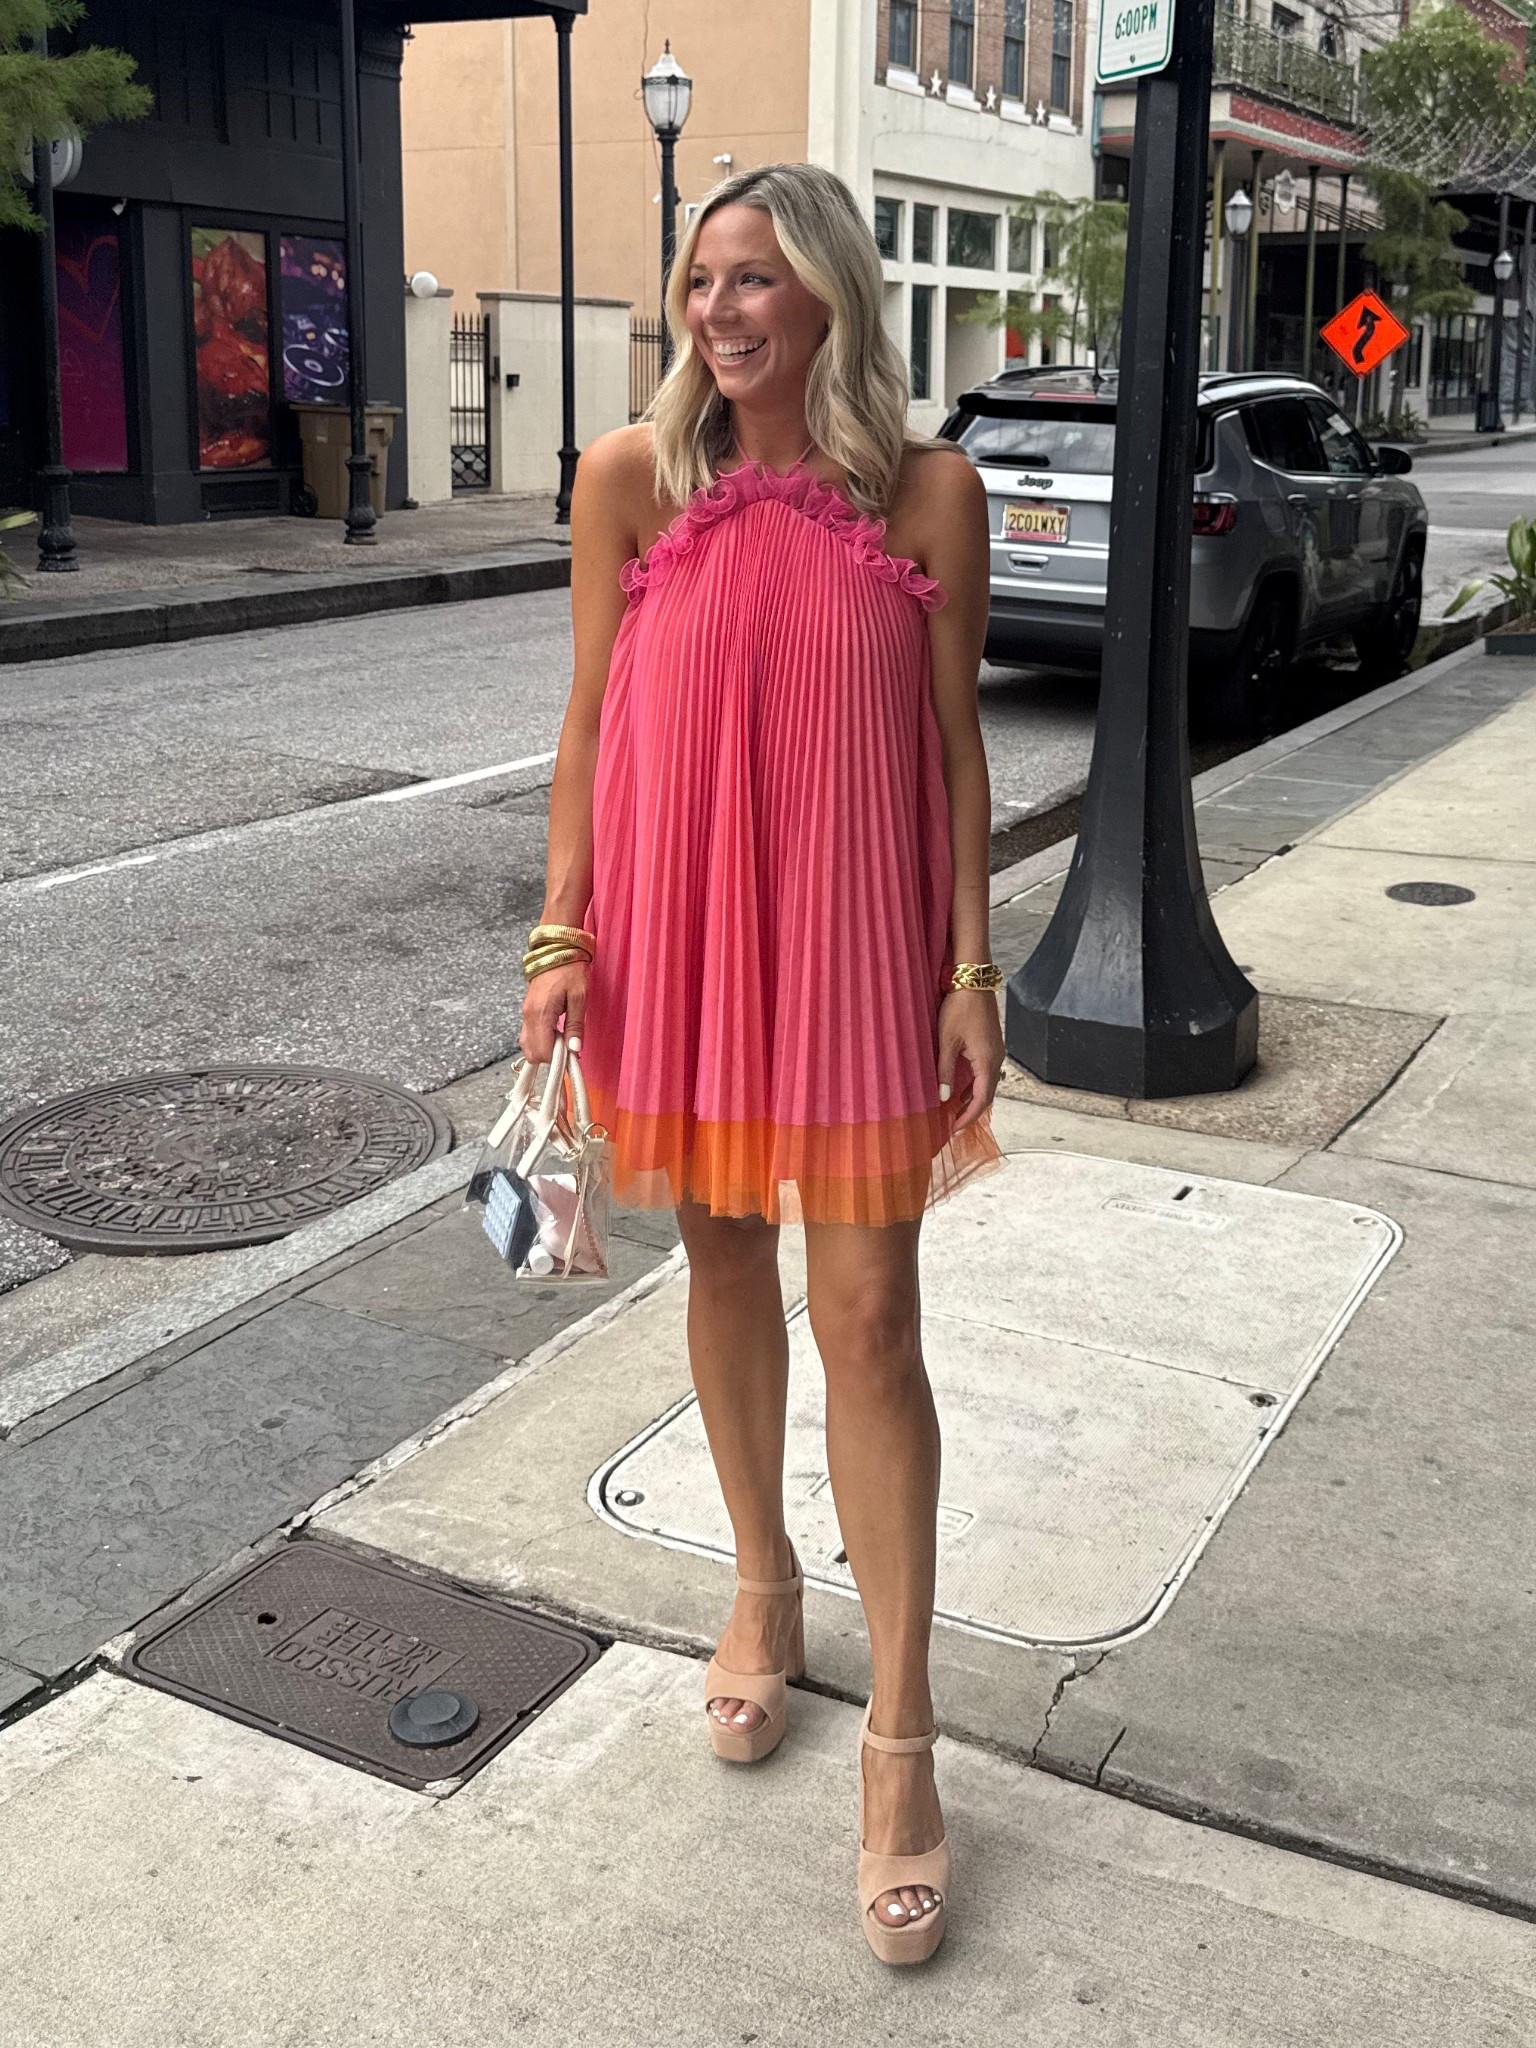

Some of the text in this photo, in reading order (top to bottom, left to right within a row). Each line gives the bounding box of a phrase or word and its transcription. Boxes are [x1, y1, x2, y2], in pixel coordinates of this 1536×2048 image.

[1115, 2, 1158, 40] 6:00PM
[1017, 475, 1053, 490] Jeep
[313, 1630, 421, 1679] WATER
[332, 1617, 442, 1664] METER
[273, 1642, 418, 1705] RUSSCO
